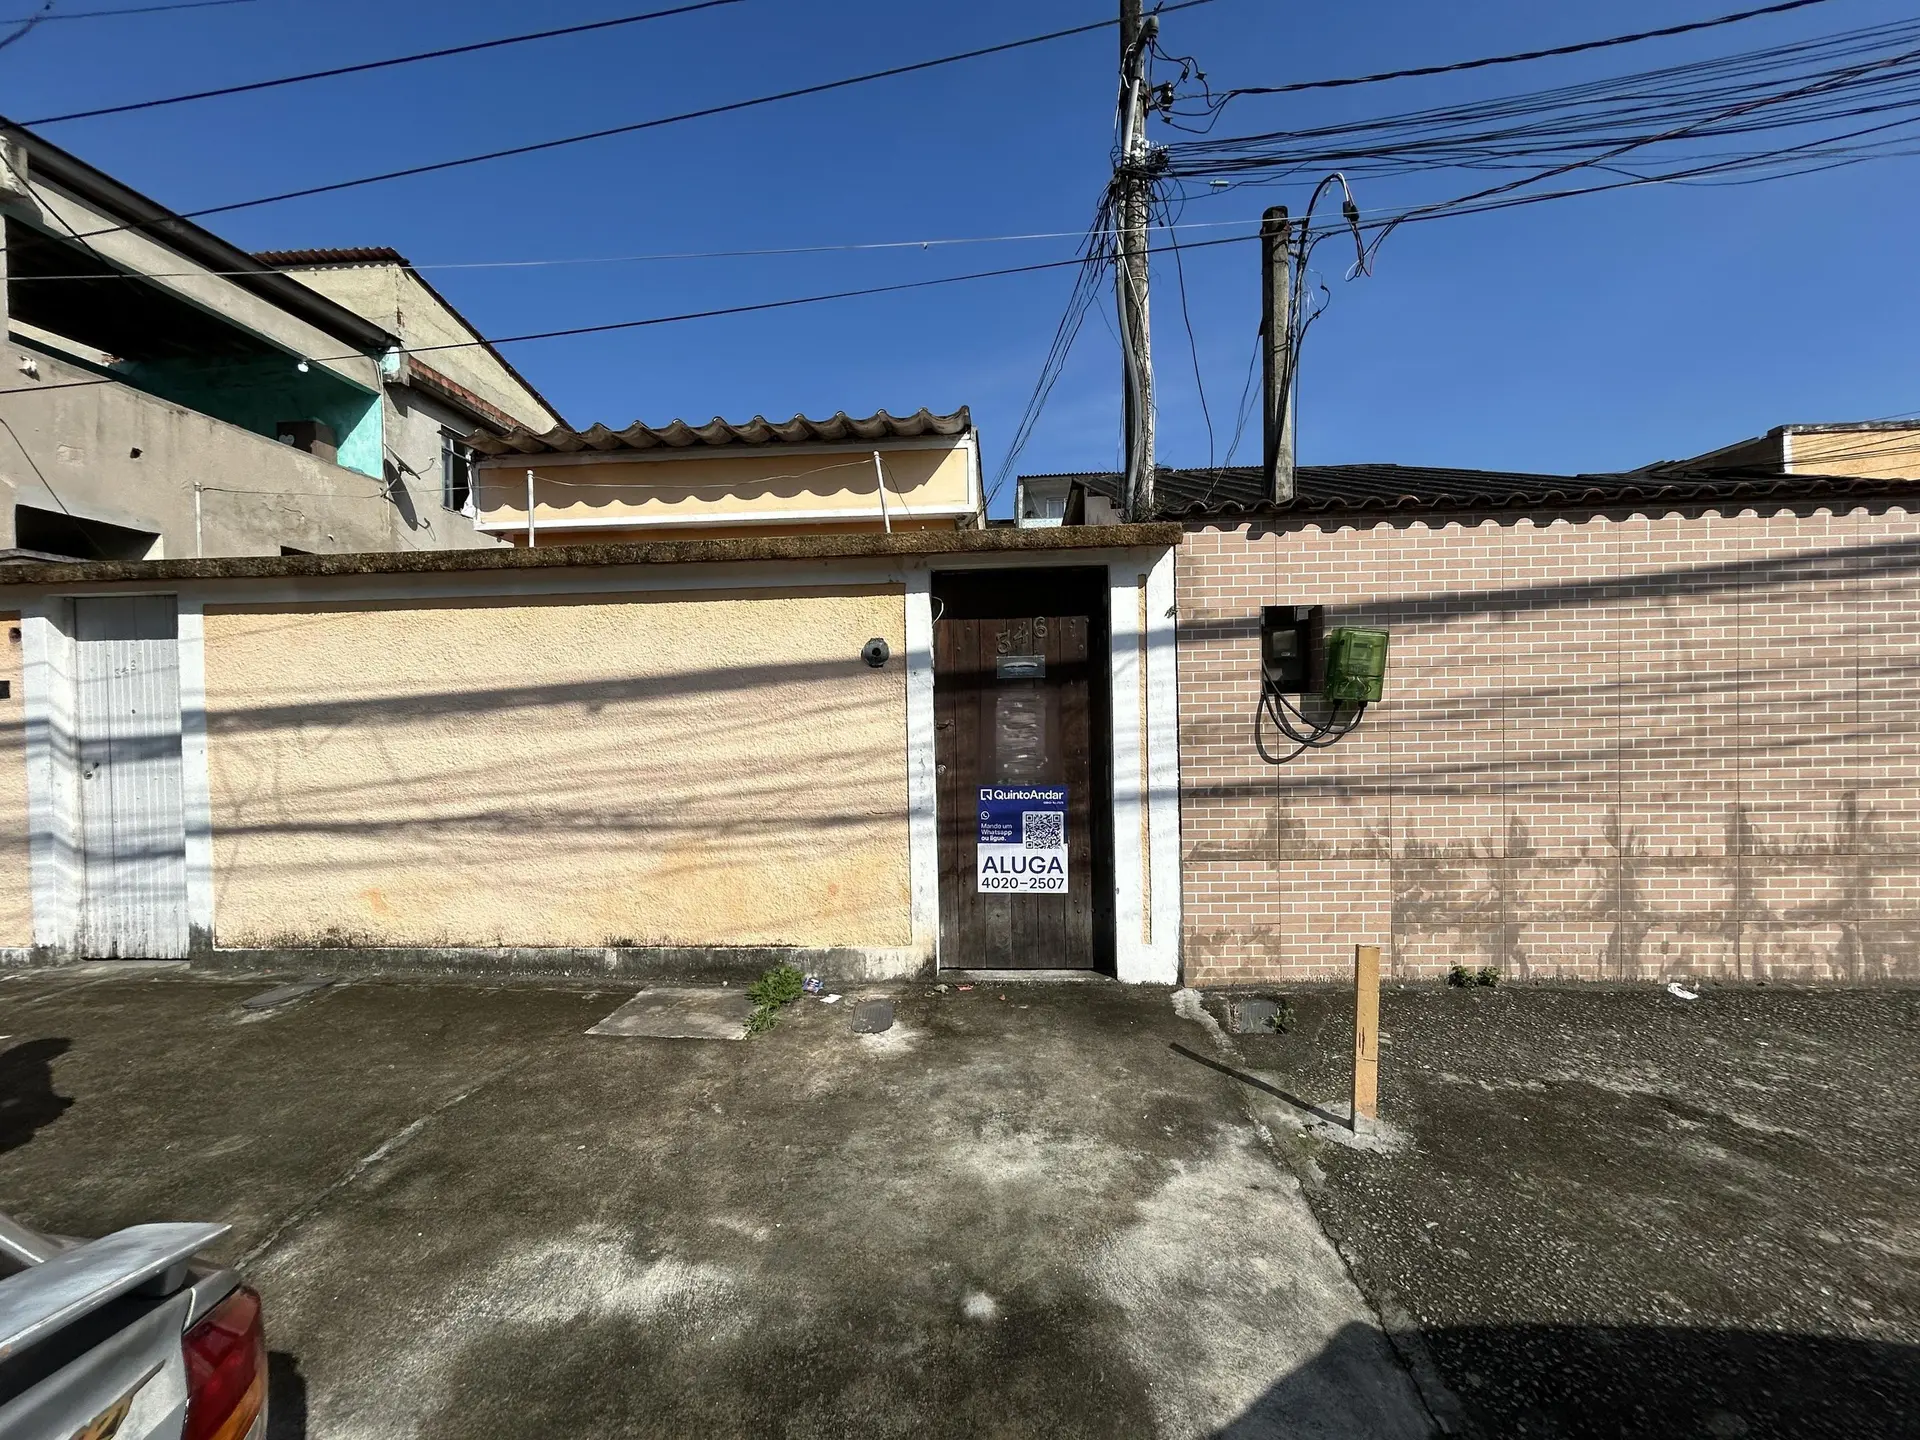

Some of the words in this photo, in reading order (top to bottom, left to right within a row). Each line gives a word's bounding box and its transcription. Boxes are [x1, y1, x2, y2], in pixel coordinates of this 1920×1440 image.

[994, 790, 1063, 800] QuintoAndar
[981, 829, 1012, 838] Whatsapp
[982, 856, 1063, 874] ALUGA
[982, 877, 1064, 889] 4020-2507
